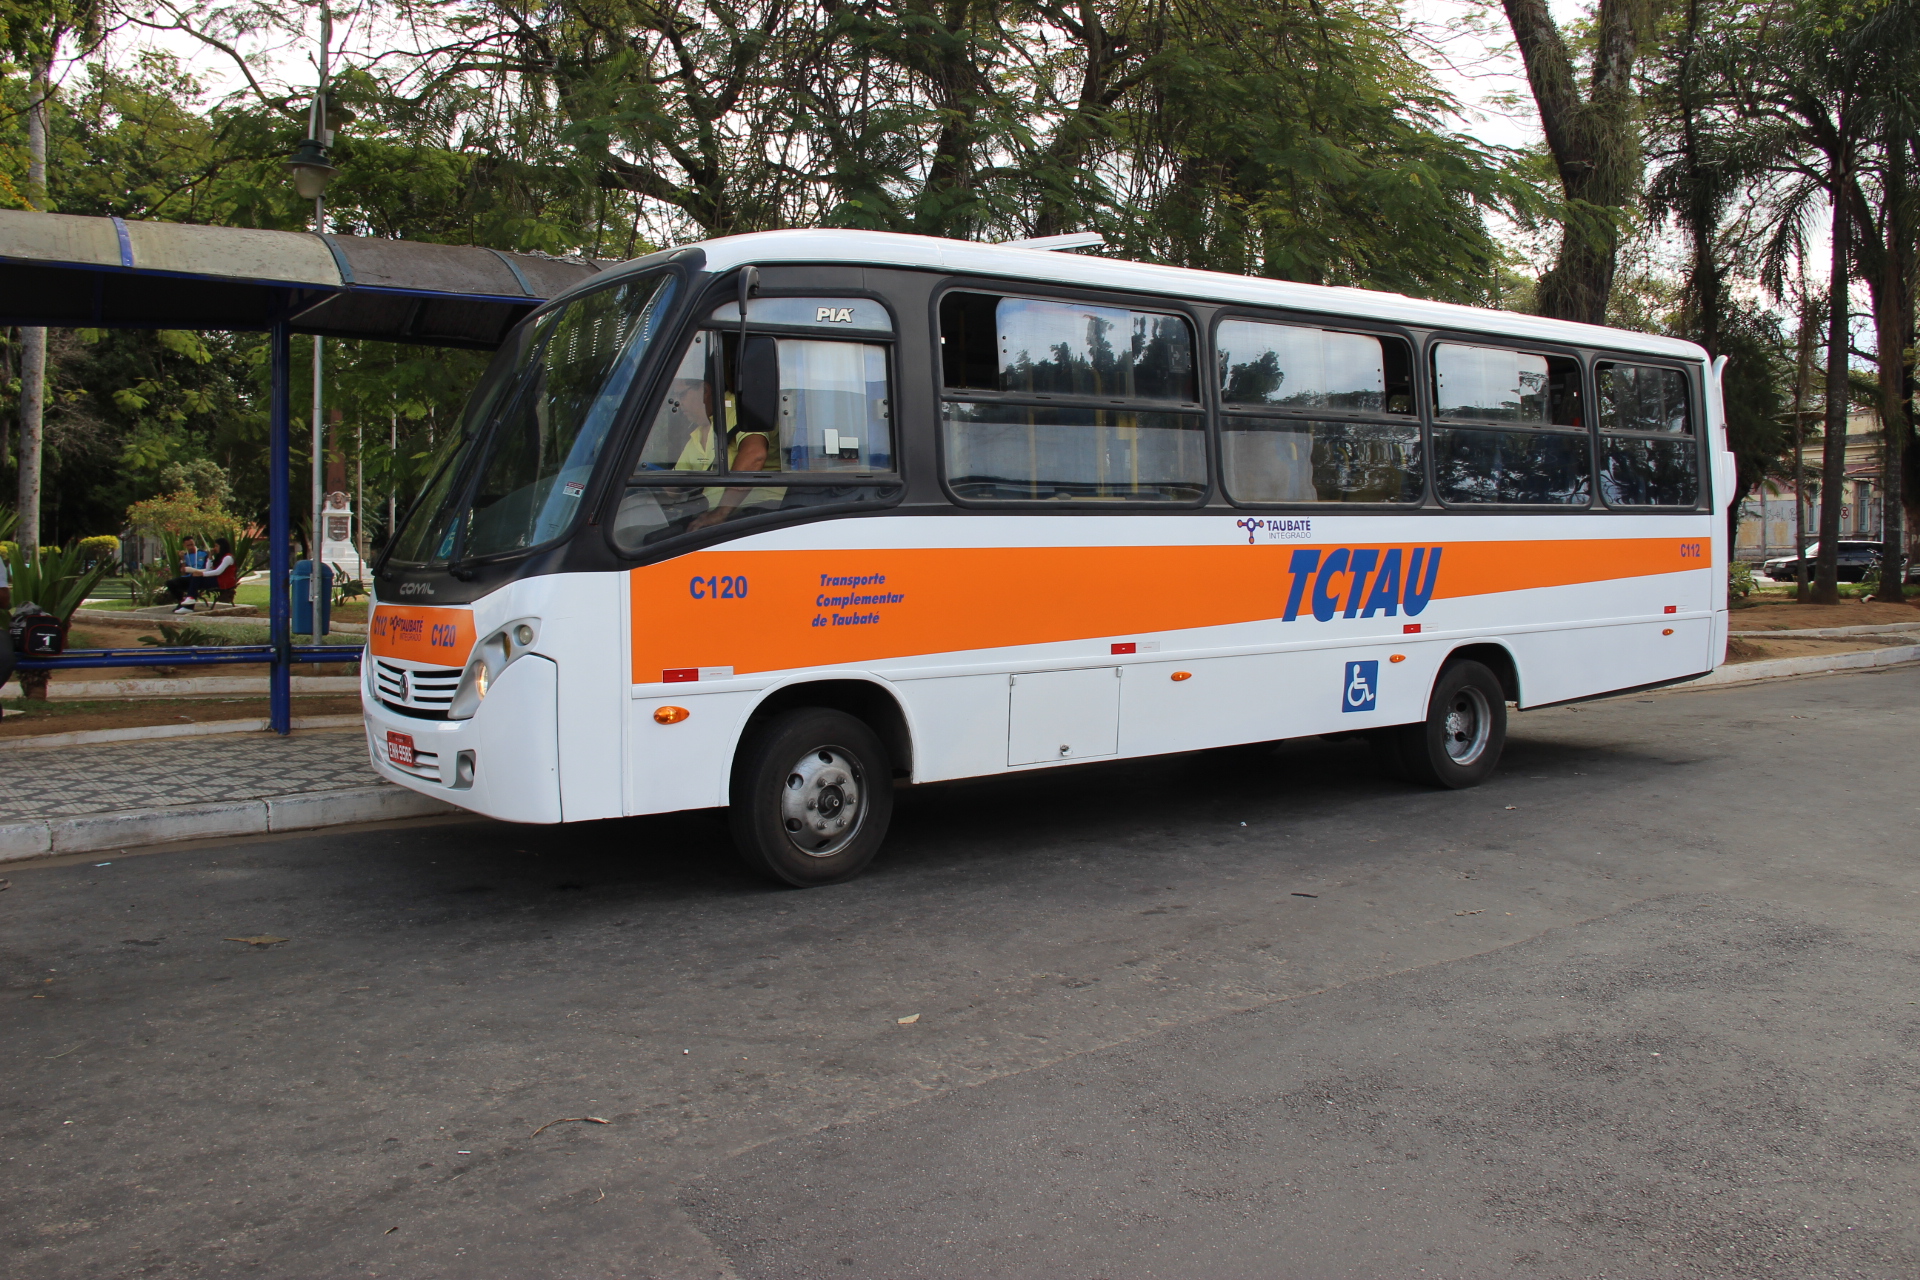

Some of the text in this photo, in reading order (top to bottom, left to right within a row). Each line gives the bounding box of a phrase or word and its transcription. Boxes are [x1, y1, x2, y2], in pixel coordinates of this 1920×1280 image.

[816, 307, 854, 323] PIÁ
[1266, 516, 1311, 531] TAUBATÉ
[1268, 531, 1311, 539] INTEGRADO
[1680, 543, 1701, 557] C112
[400, 582, 435, 595] COMIL
[689, 575, 748, 599] C120
[820, 573, 886, 589] Transporte
[1281, 547, 1443, 623] TCTAU
[816, 592, 905, 609] Complementar
[400, 615, 424, 633] TAUBATÉ
[811, 611, 880, 627] de Taubaté
[42, 636, 50, 646] 1
[431, 623, 457, 648] C120
